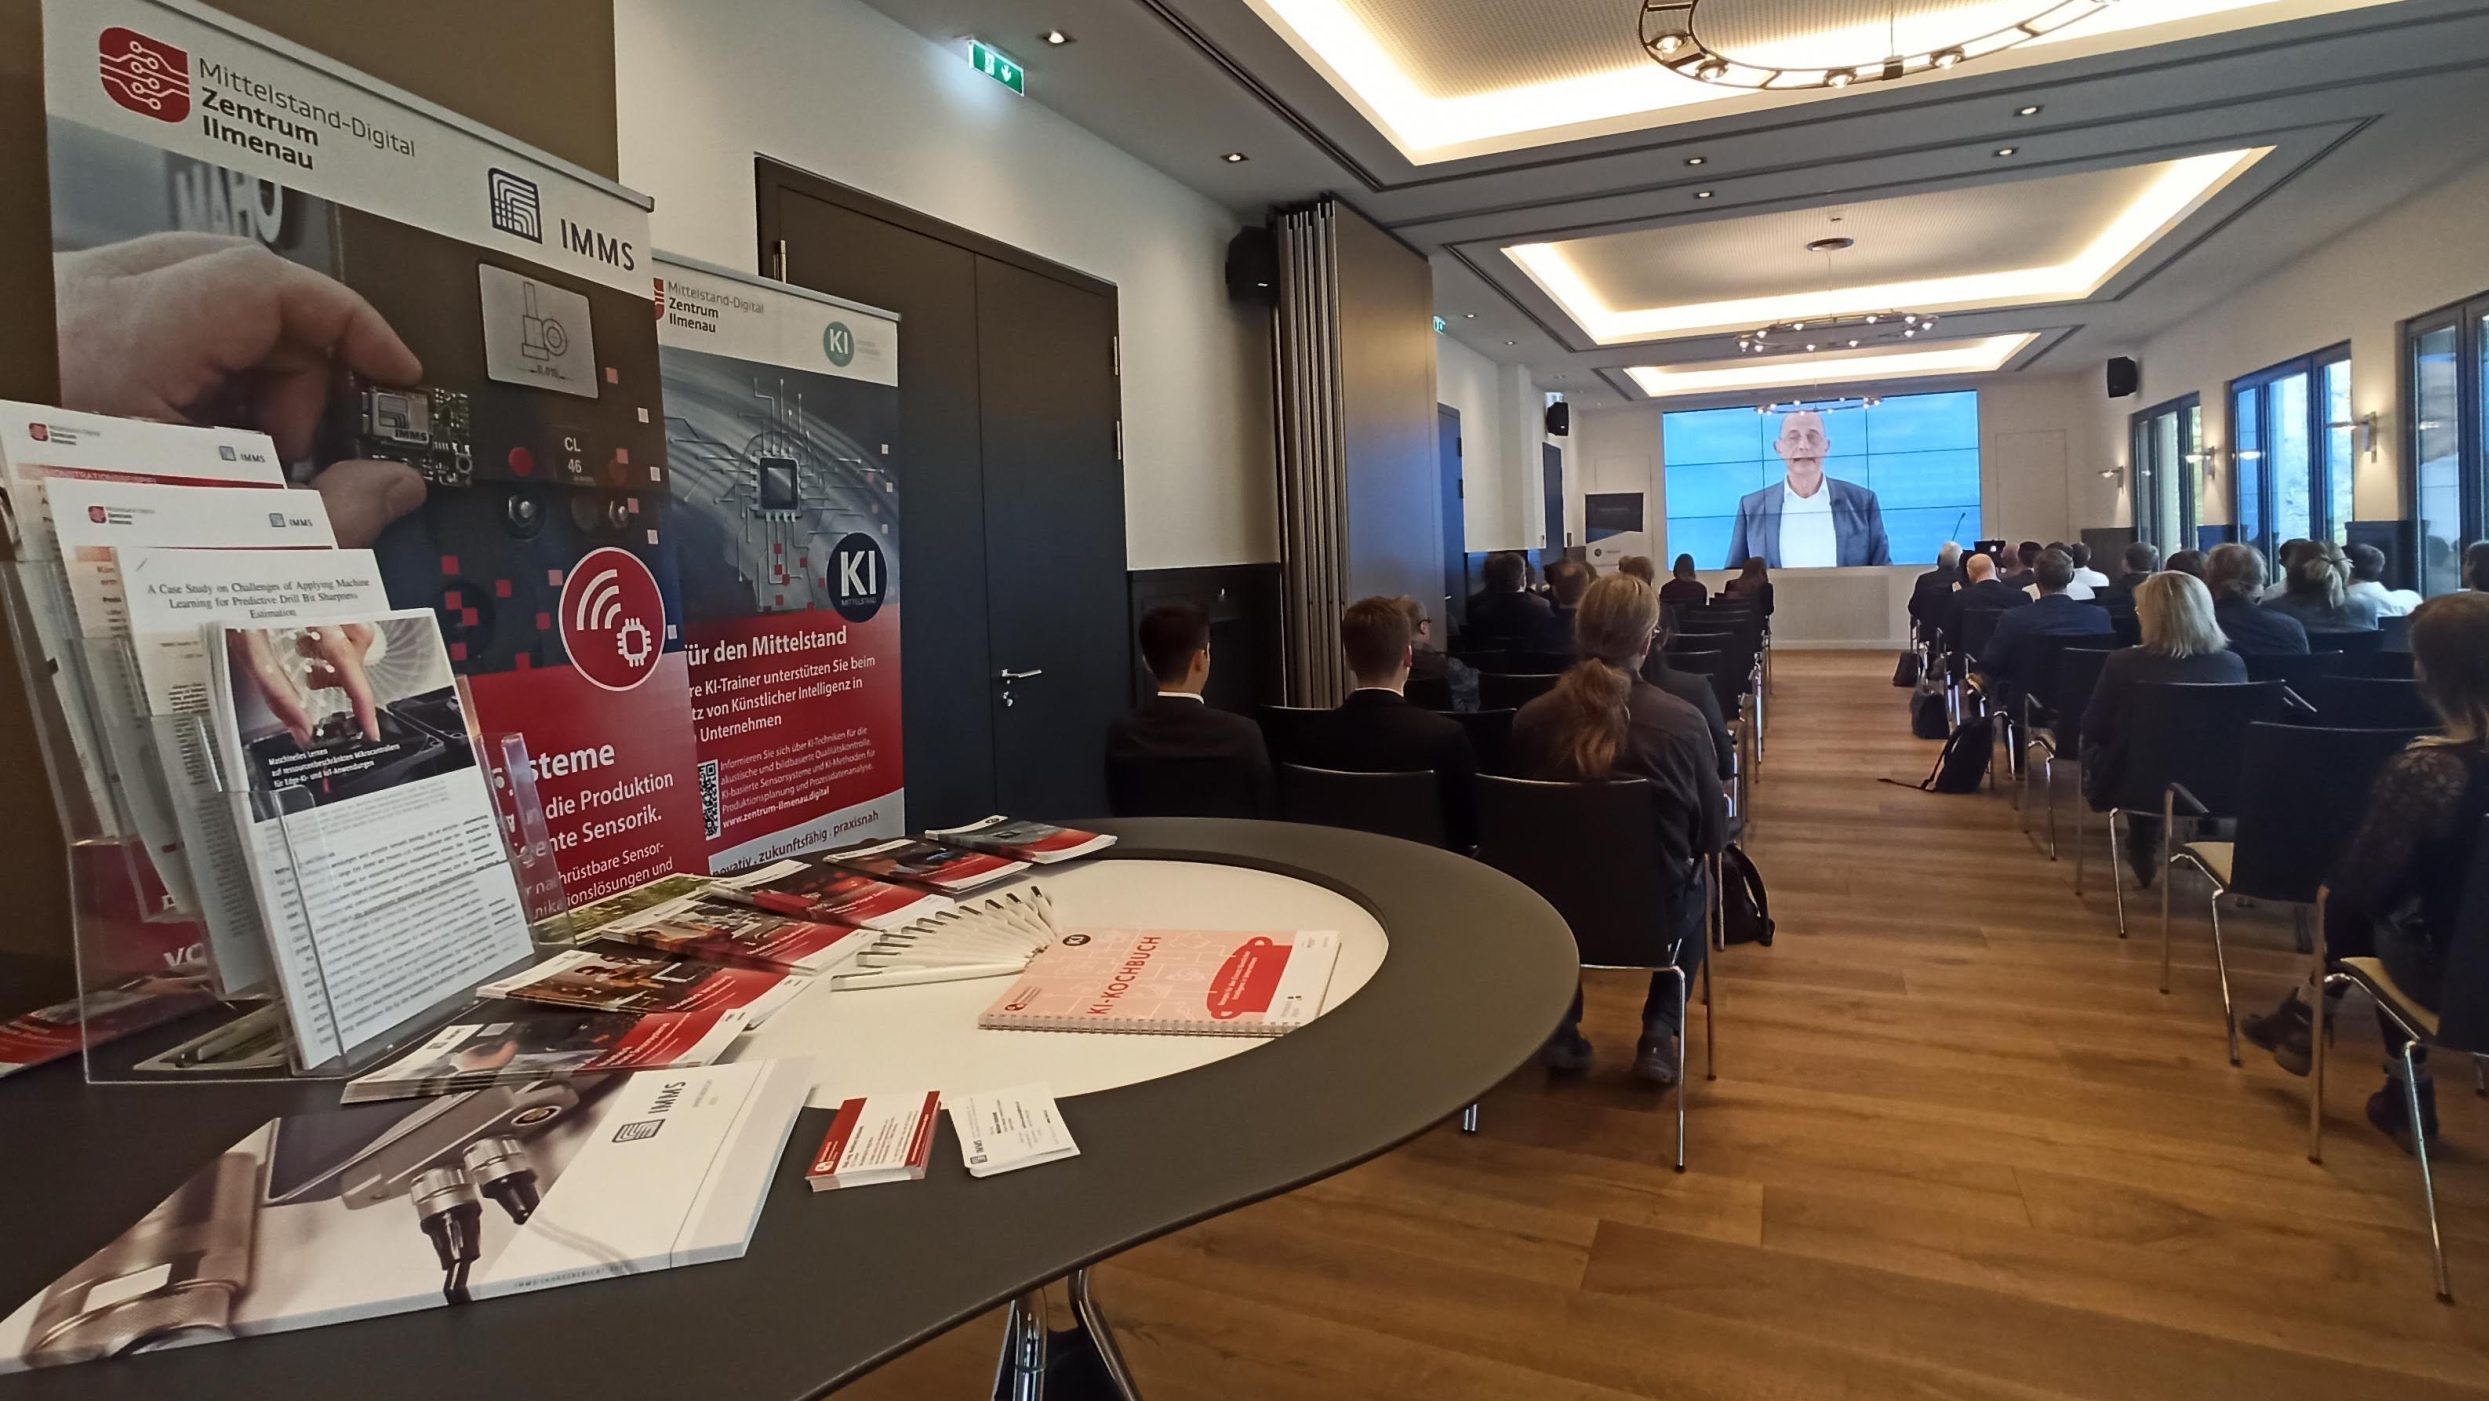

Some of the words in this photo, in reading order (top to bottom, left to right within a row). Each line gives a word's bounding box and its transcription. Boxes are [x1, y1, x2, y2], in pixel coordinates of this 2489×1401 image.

[199, 57, 416, 157] Mittelstand-Digital
[201, 86, 319, 146] Zentrum
[203, 115, 314, 170] Ilmenau
[560, 218, 635, 271] IMMS
[668, 280, 764, 313] Mittelstand-Digital
[669, 297, 719, 318] Zentrum
[669, 313, 716, 333] Ilmenau
[829, 328, 849, 355] KI
[564, 436, 582, 452] CL
[567, 459, 582, 473] 46
[148, 585, 156, 594] A
[159, 584, 182, 594] Case
[186, 583, 213, 595] Study
[231, 582, 281, 594] Challenges
[283, 581, 292, 591] of
[296, 579, 334, 592] Applying
[335, 578, 370, 588] Machine
[840, 550, 877, 597] KI
[169, 597, 213, 610] Learning
[215, 596, 229, 607] for
[232, 594, 277, 606] Predictive
[279, 593, 300, 604] Drill
[302, 593, 316, 603] Bit
[318, 591, 358, 603] Sharpness
[249, 608, 297, 619] Estimation
[685, 643, 710, 666] ür
[713, 639, 748, 663] den
[752, 625, 848, 657] Mittelstand
[689, 684, 702, 698] re
[705, 673, 761, 696] KI-Trainer
[763, 663, 831, 685] unterstützen
[832, 658, 849, 673] Sie
[850, 655, 876, 670] beim
[691, 706, 704, 721] tz
[706, 703, 730, 718] von
[731, 689, 796, 714] Künstlicher
[798, 681, 851, 700] Intelligenz
[852, 676, 863, 690] in
[699, 714, 782, 743] Unternehmen
[720, 752, 762, 771] Informieren
[763, 748, 775, 760] Sie
[775, 744, 791, 756] sich
[791, 740, 807, 753] über
[846, 728, 857, 739] für
[856, 726, 868, 736] die
[527, 743, 616, 783] steme
[720, 767, 758, 786] akustische
[758, 762, 774, 776] und
[759, 766, 812, 789] Sensorsysteme
[812, 760, 825, 772] und
[866, 748, 876, 759] für
[545, 796, 576, 820] die
[580, 772, 674, 811] Produktion
[721, 786, 795, 815] Produktionsplanung
[796, 779, 809, 792] und
[722, 785, 830, 829] www.zentrum-ilmenau.digital
[582, 803, 662, 843] Sensorik.
[713, 855, 752, 876] novativ
[759, 828, 828, 861] zukunftsfähig
[833, 809, 879, 837] praxisnah
[622, 841, 665, 865] Sensor-
[535, 868, 650, 919] nikaionslösungen
[652, 856, 673, 877] und
[1087, 935, 1162, 1015] KI-KOCHBUCH
[647, 1081, 687, 1114] IMMS
